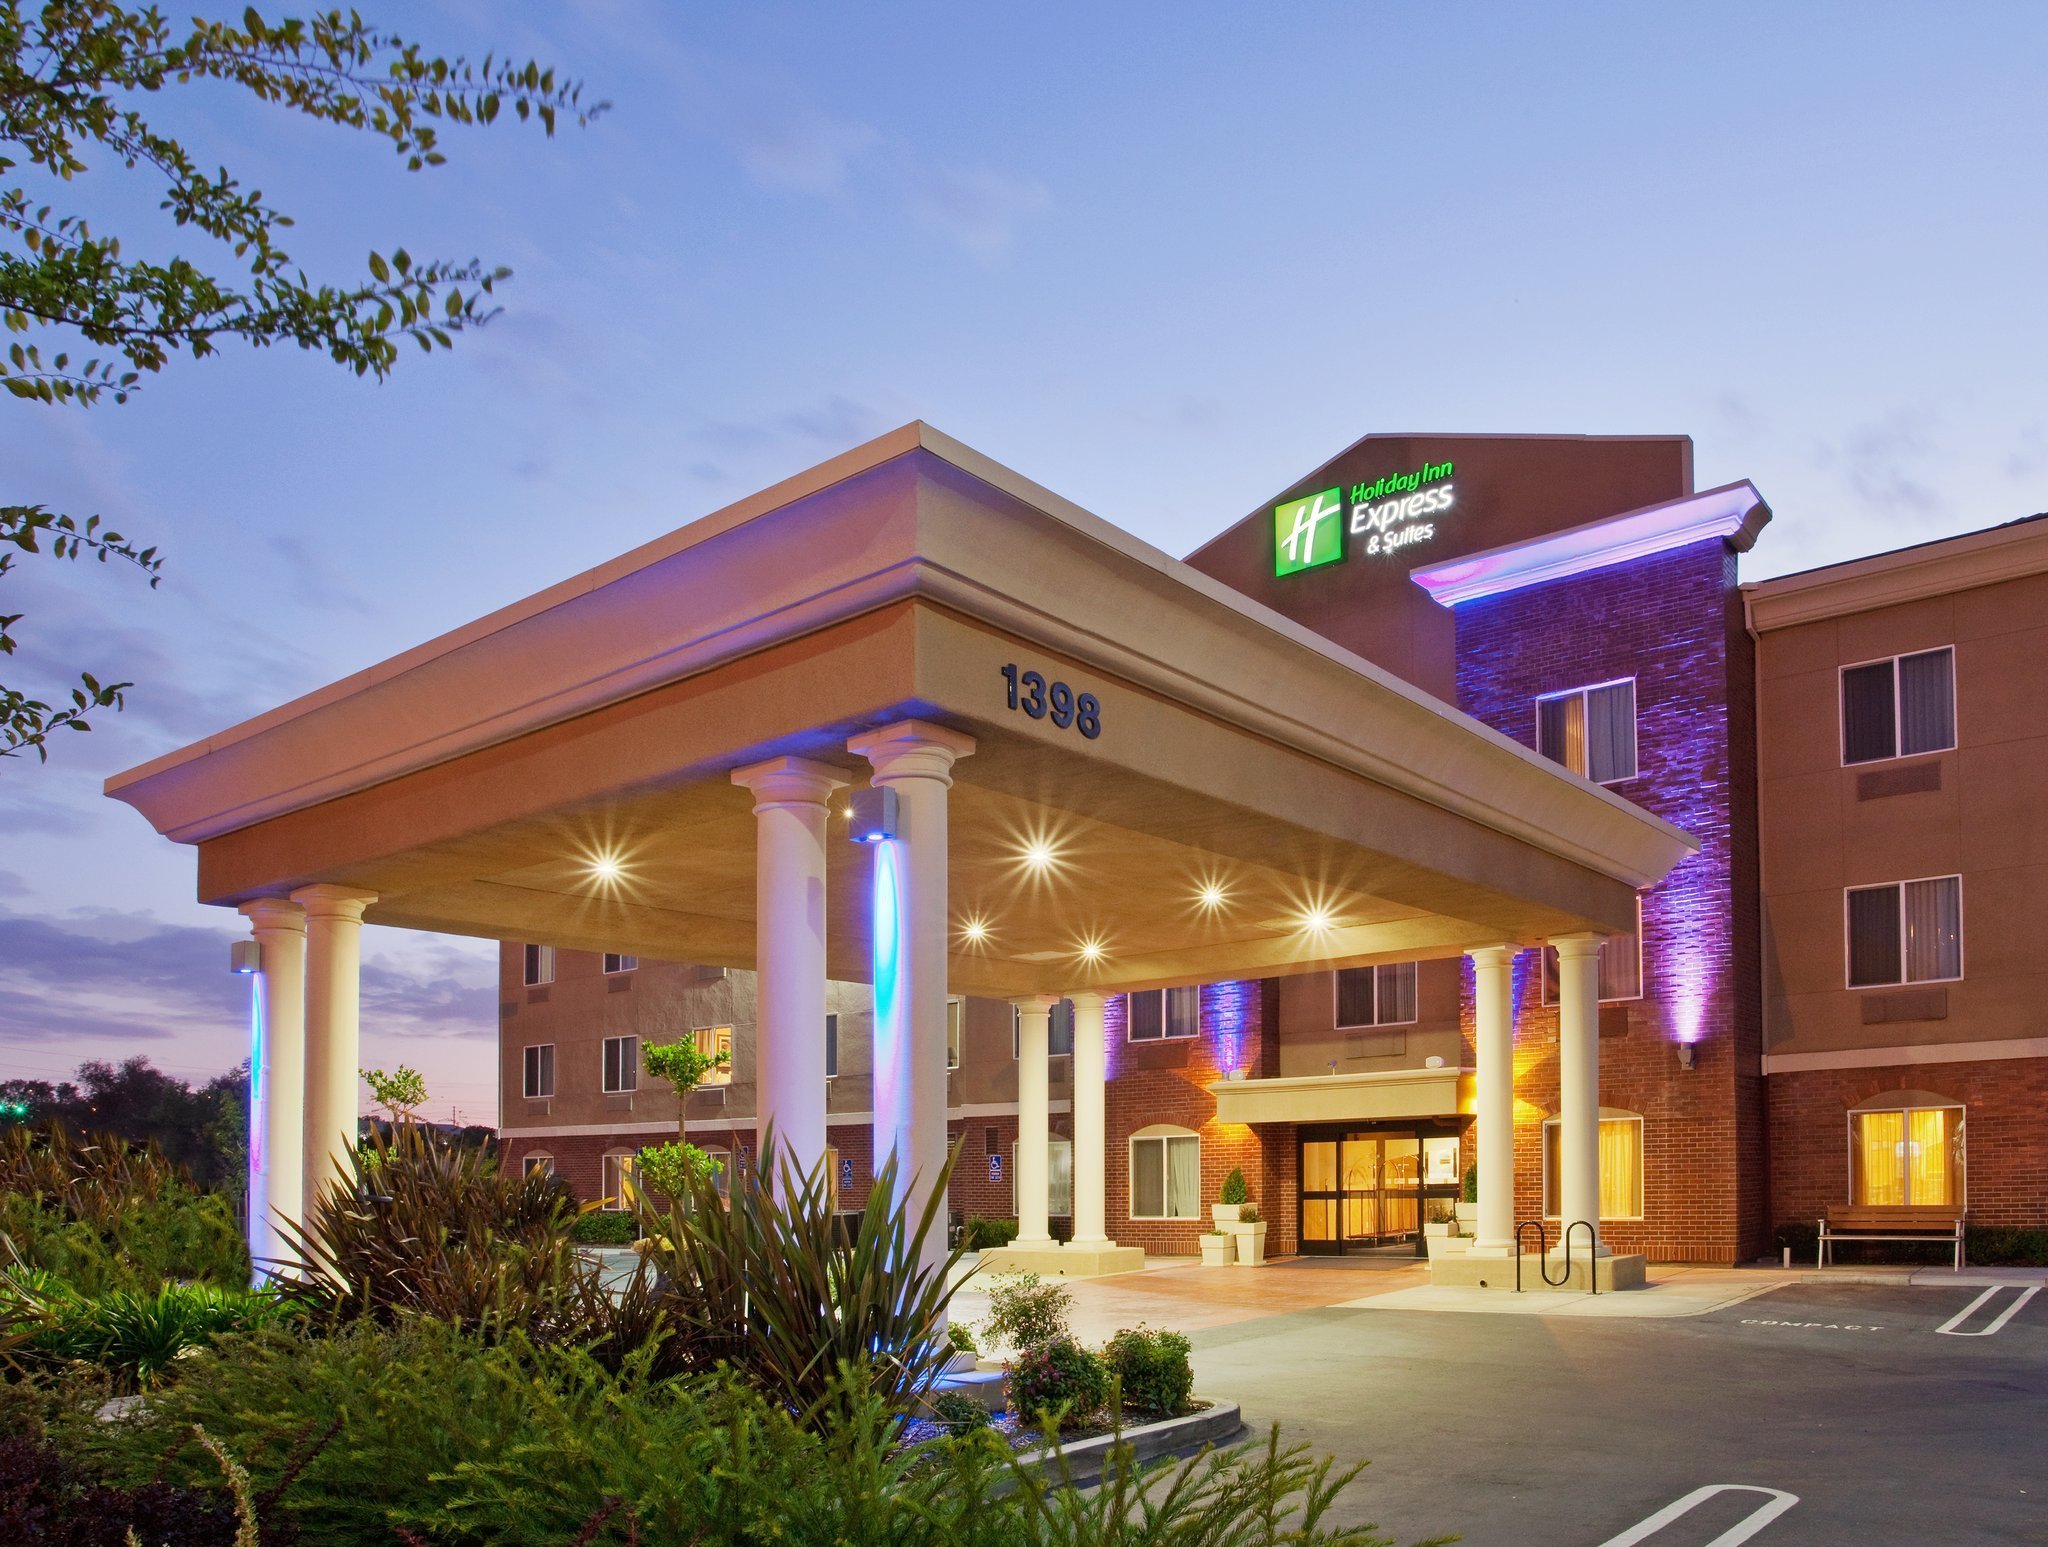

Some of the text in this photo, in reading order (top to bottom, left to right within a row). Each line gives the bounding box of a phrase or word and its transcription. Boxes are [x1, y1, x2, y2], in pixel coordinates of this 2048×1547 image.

[1350, 462, 1453, 504] Holiday Inn
[1350, 484, 1454, 534] Express
[1367, 523, 1434, 554] & Suites
[1001, 663, 1101, 740] 1398
[1740, 1319, 1885, 1331] COMPACT
